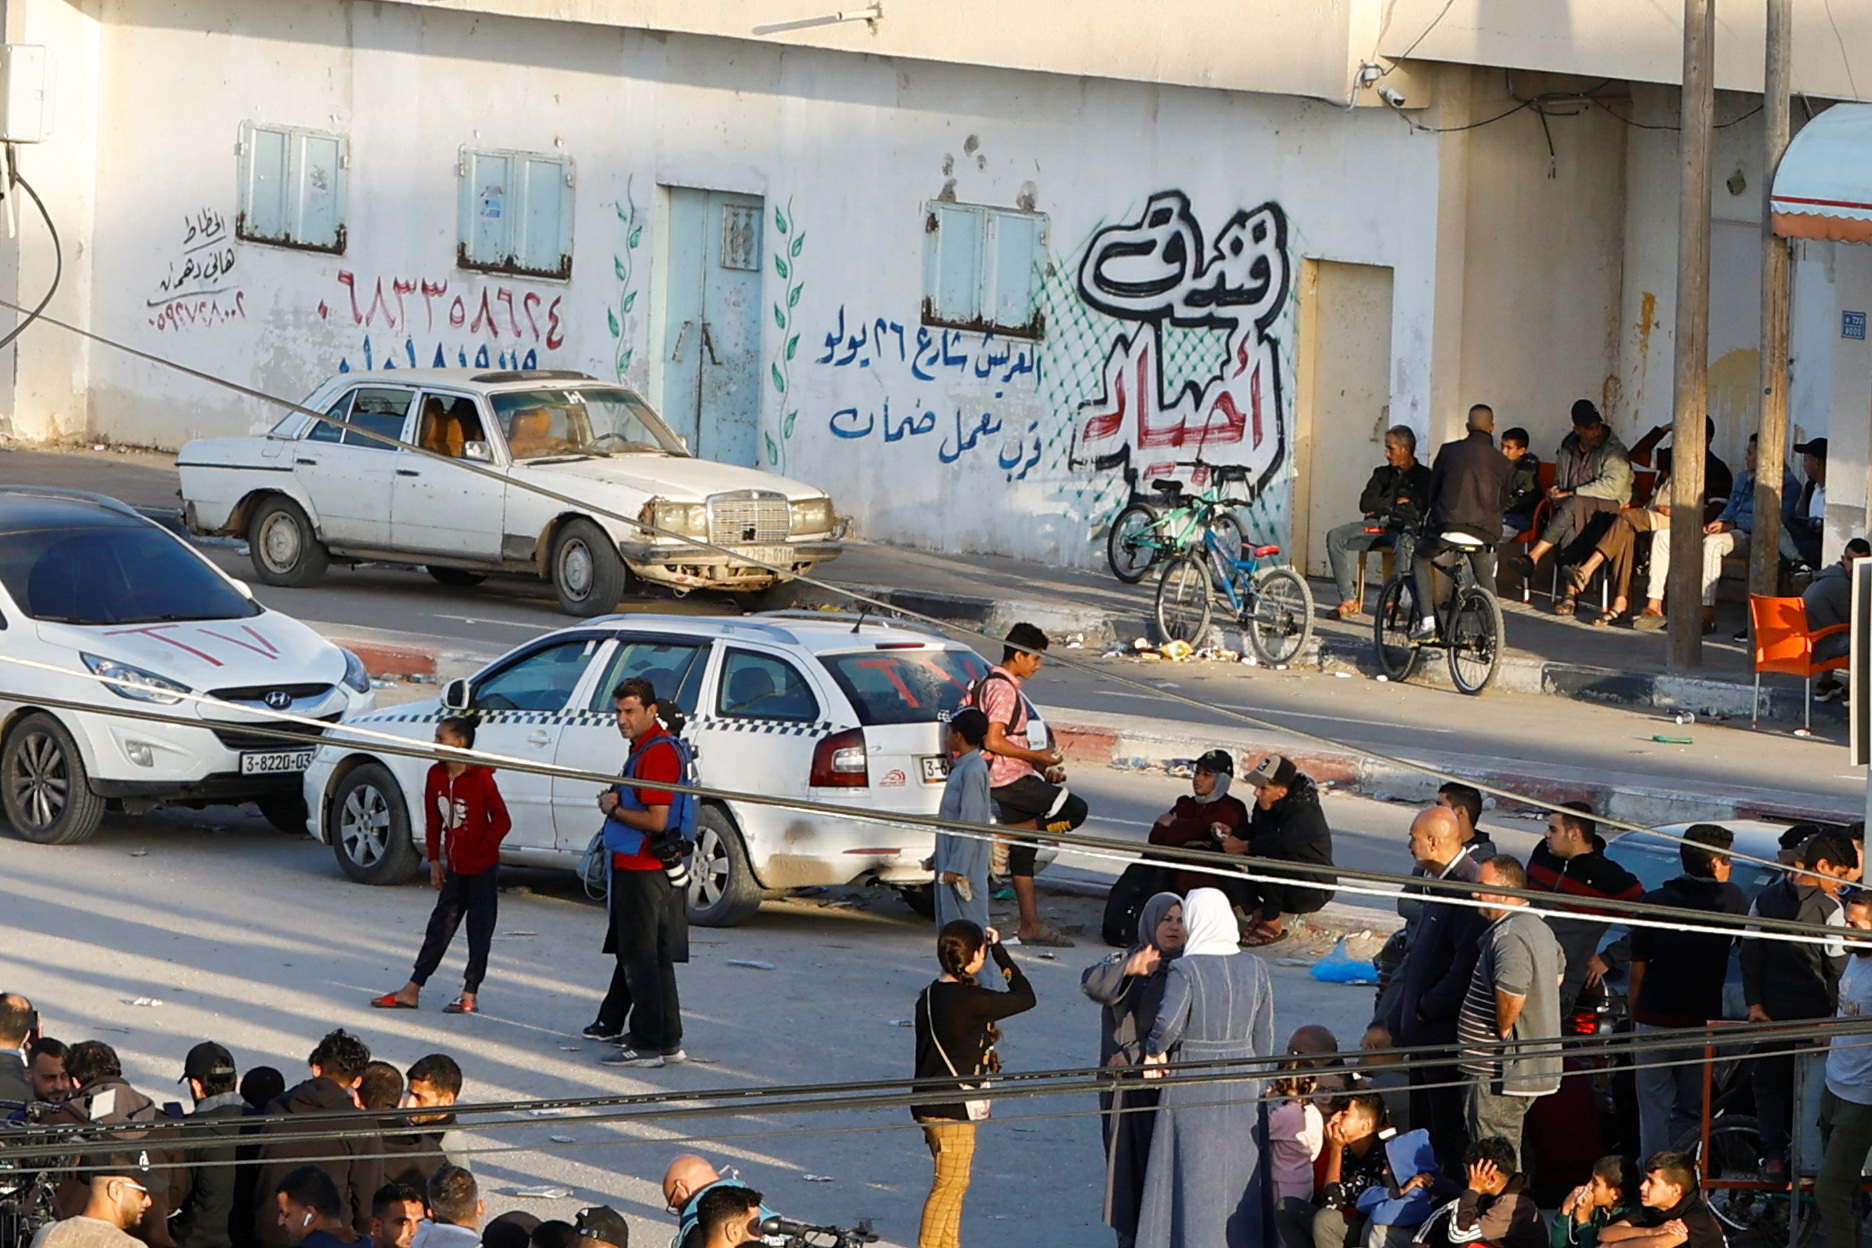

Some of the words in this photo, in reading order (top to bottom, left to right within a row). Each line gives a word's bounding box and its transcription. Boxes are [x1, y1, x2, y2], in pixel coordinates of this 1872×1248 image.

[1086, 199, 1280, 318] فندق
[104, 625, 280, 666] TV
[246, 753, 311, 772] 3-8220-03
